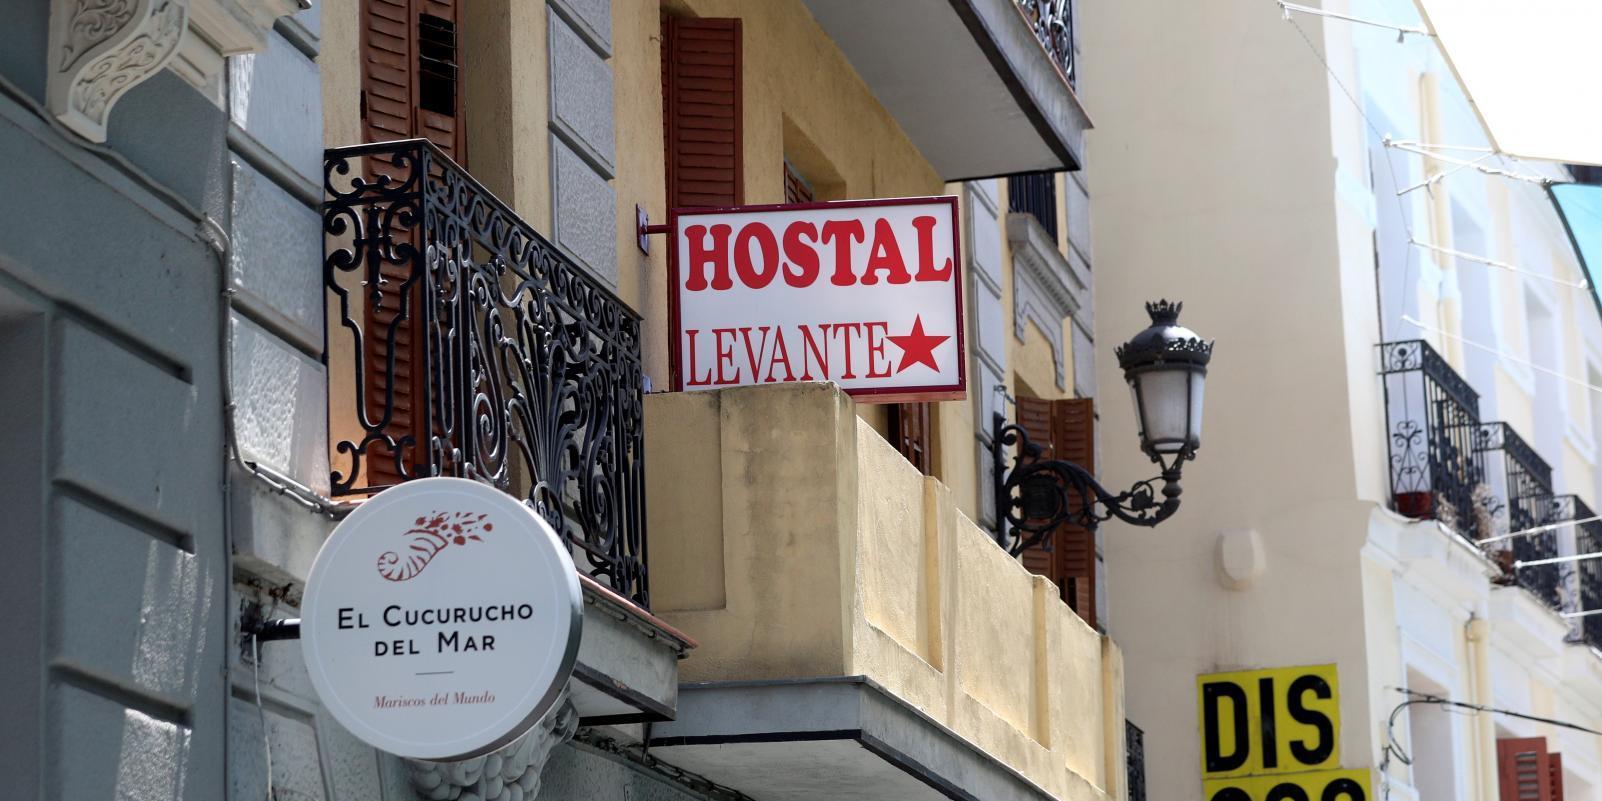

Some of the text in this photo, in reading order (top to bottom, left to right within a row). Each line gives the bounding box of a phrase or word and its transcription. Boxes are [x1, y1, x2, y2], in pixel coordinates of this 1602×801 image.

[684, 215, 953, 292] HOSTAL
[685, 321, 892, 386] LEVANTE
[338, 604, 533, 630] EL CUCURUCHO
[375, 631, 496, 657] DEL MAR
[373, 690, 496, 709] Mariscos del Mundo
[1203, 674, 1334, 773] DIS
